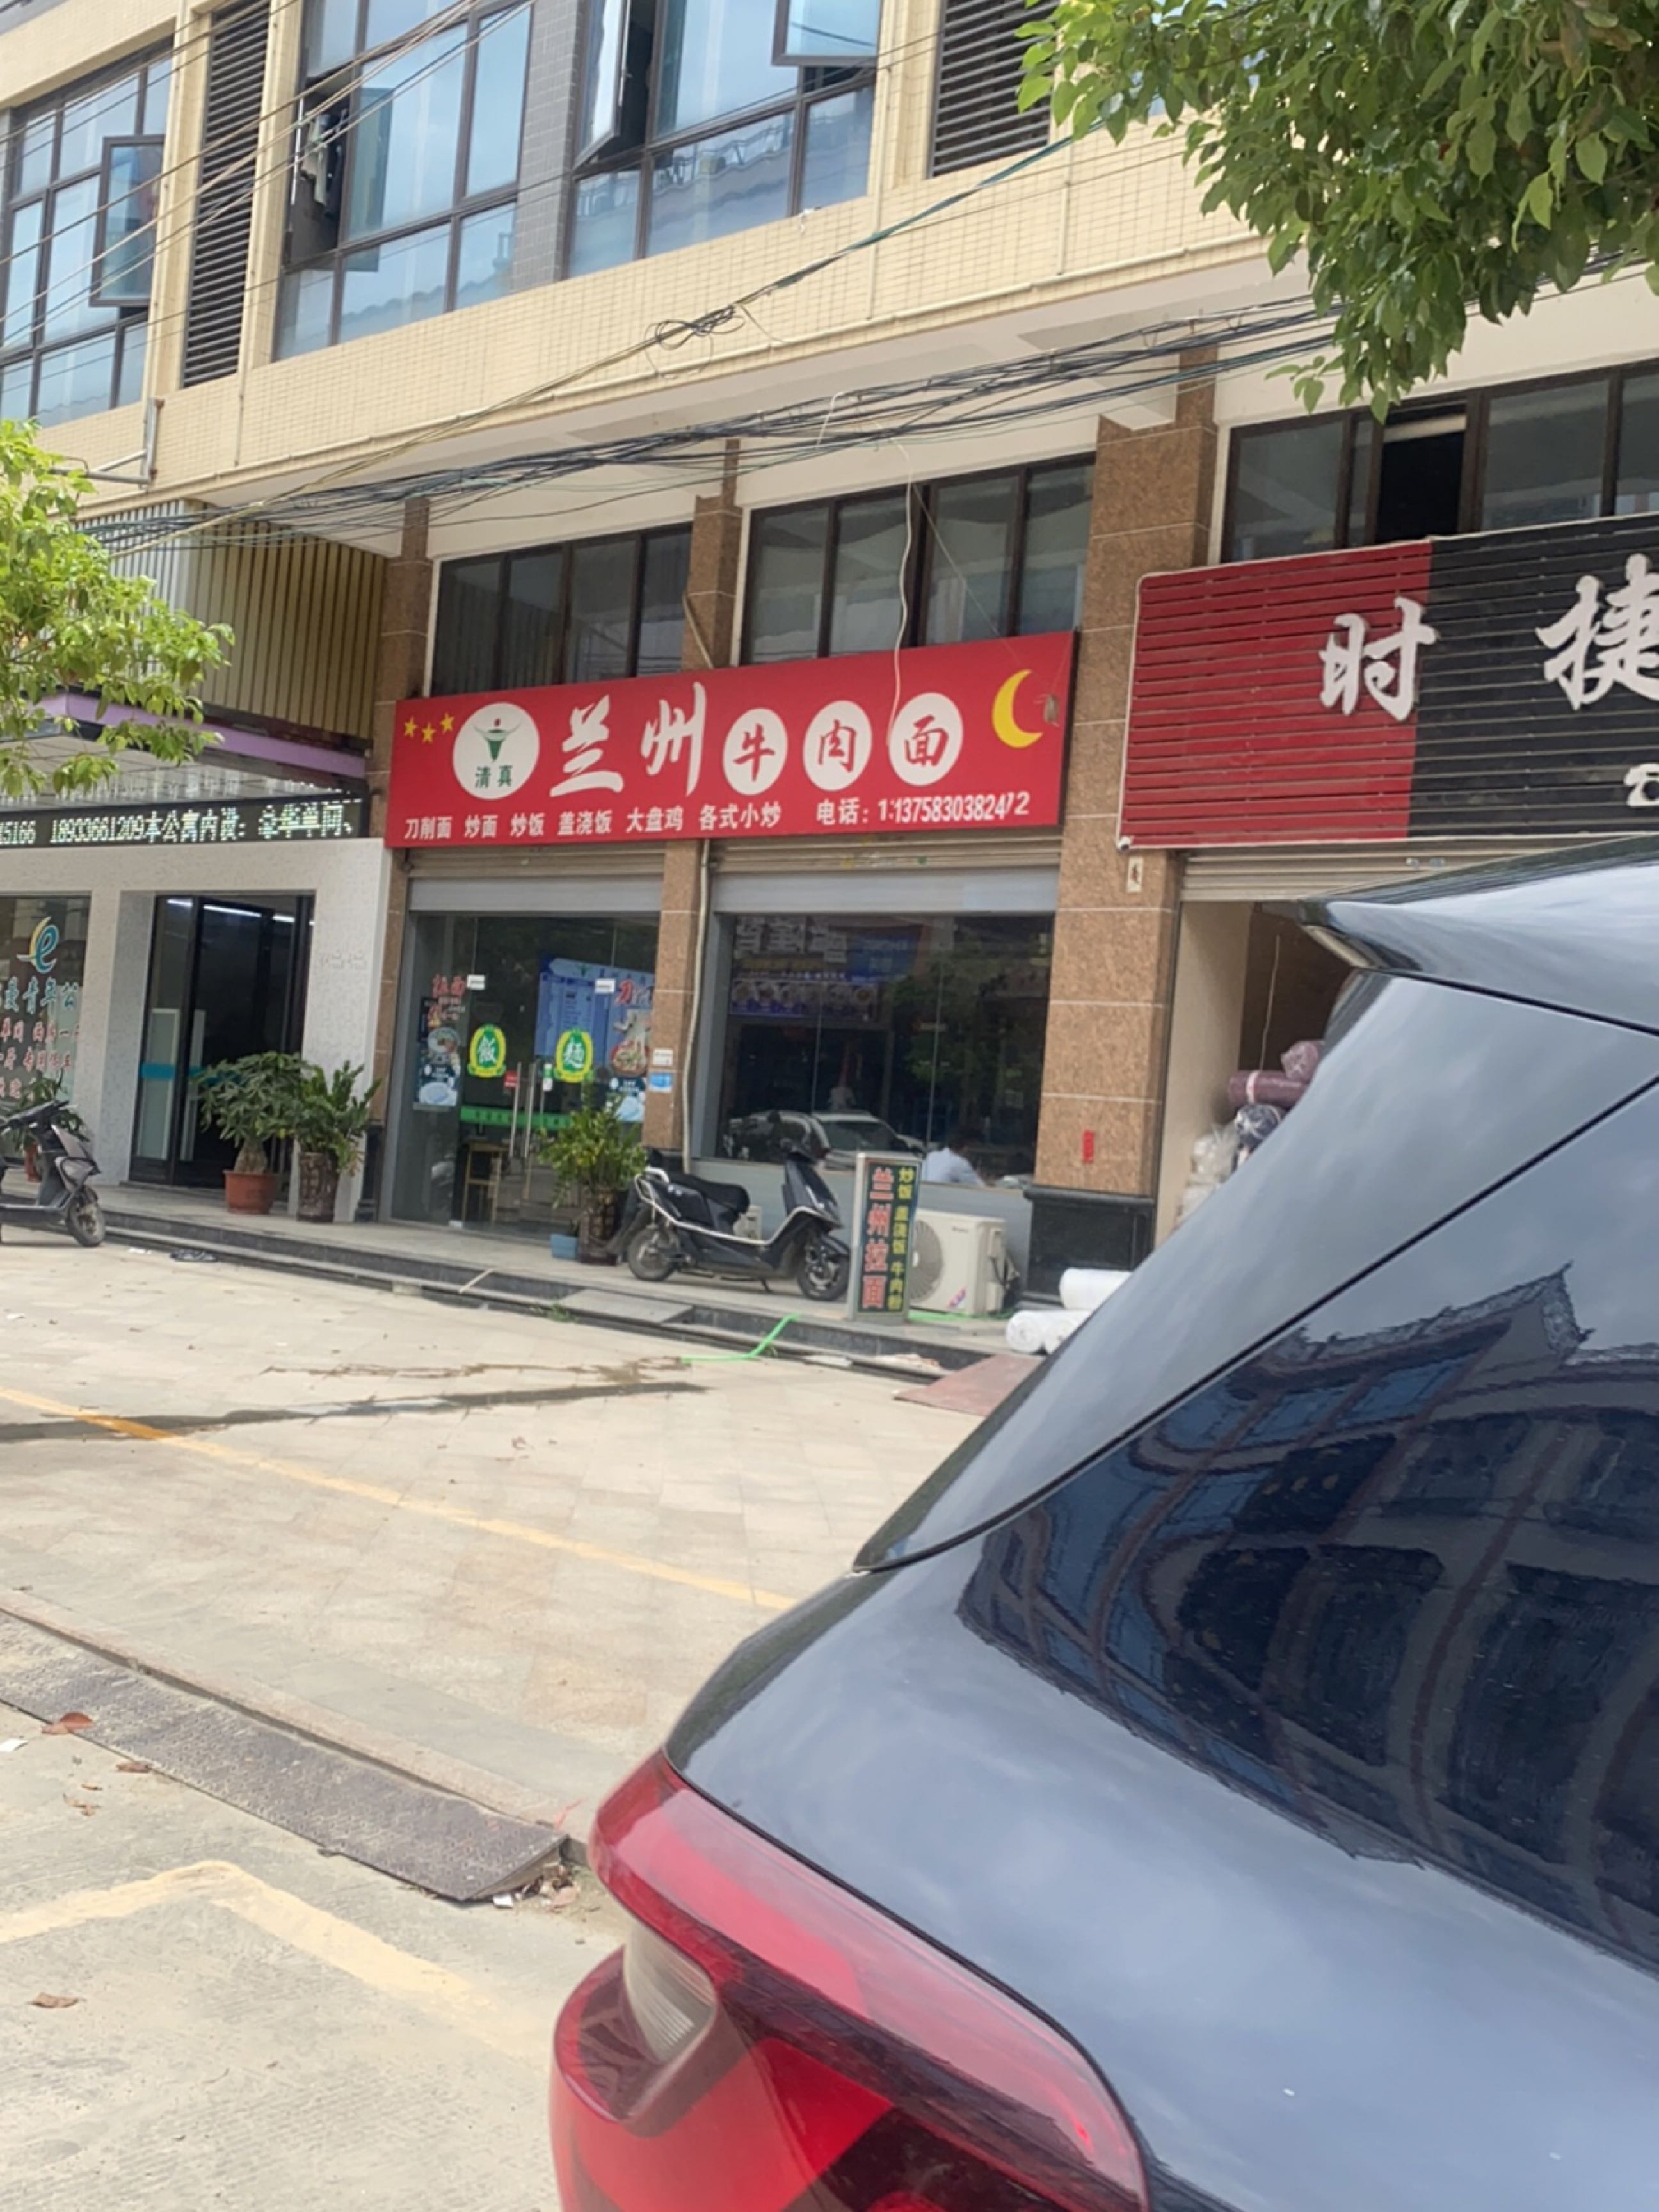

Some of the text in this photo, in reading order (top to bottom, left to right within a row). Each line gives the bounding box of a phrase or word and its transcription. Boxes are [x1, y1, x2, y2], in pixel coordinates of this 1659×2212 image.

[474, 764, 513, 789] 清真
[549, 681, 950, 797] 兰州牛肉面
[404, 816, 453, 840] 刀削面
[464, 814, 499, 839] 炒面
[510, 812, 545, 837] 炒饭
[557, 810, 612, 835] 盖浇饭
[626, 806, 684, 833] 大盘鸡
[700, 801, 783, 830] 各式小炒
[862, 1166, 895, 1310] 兰州拉面
